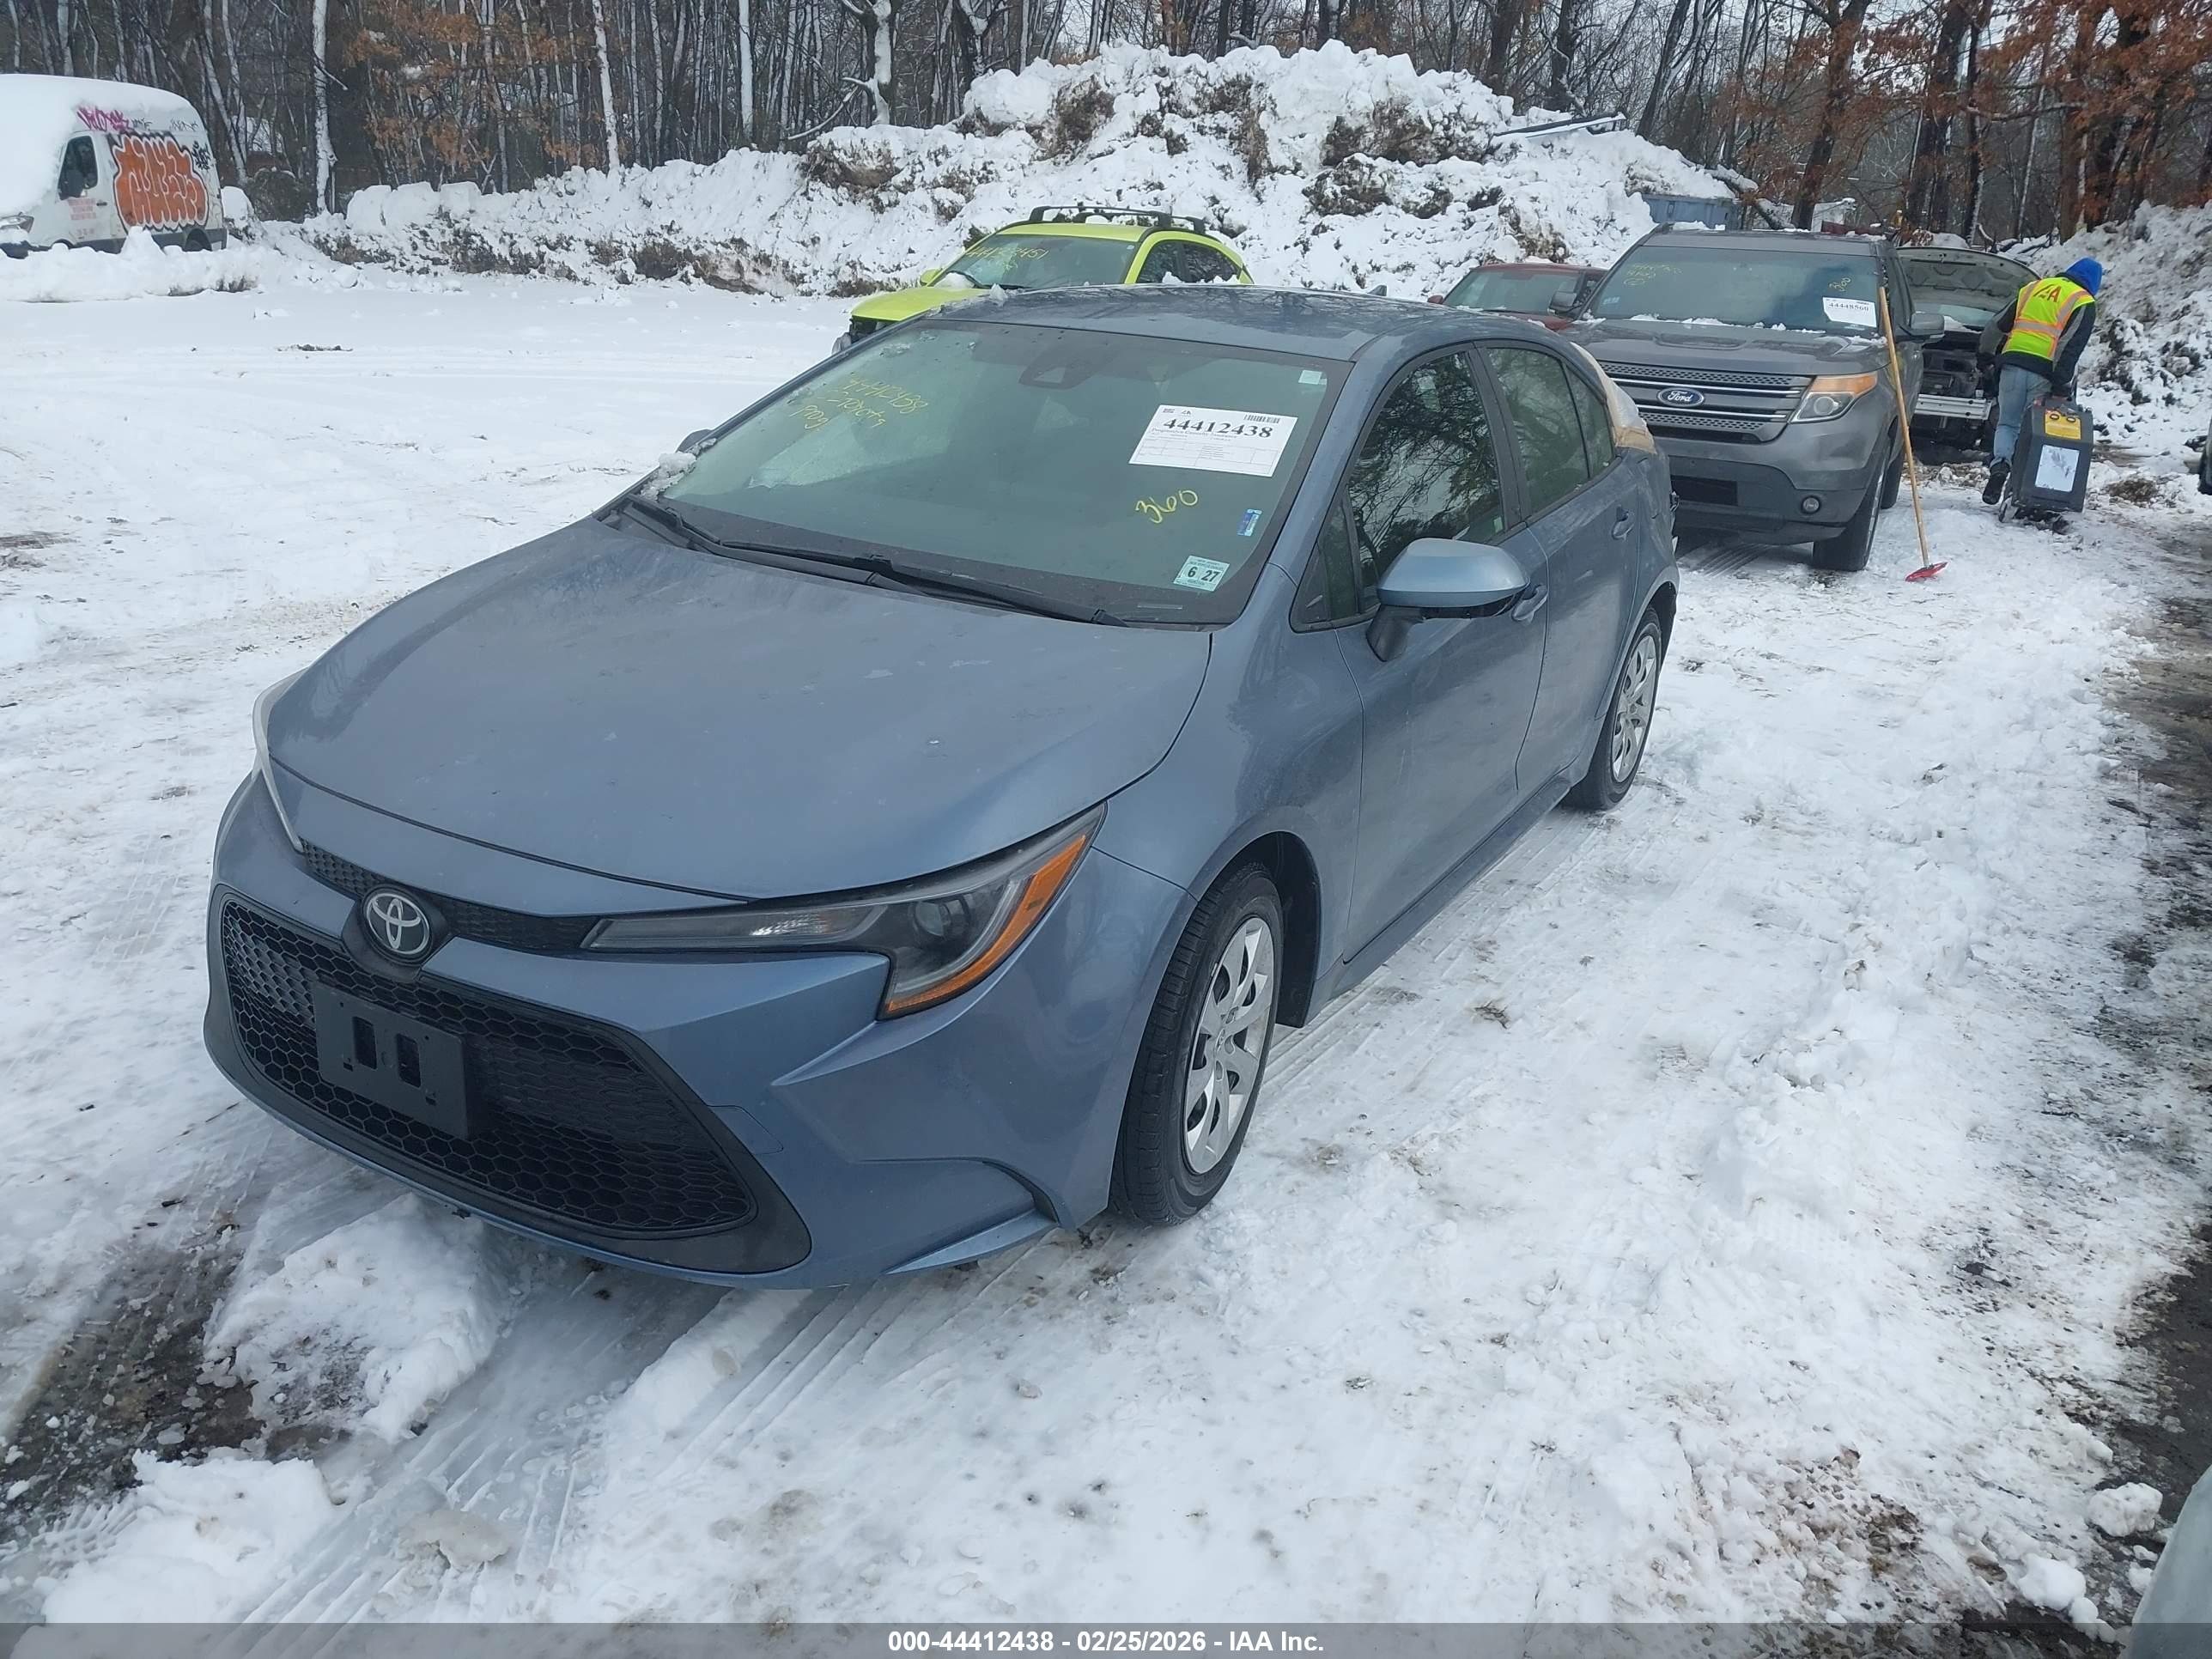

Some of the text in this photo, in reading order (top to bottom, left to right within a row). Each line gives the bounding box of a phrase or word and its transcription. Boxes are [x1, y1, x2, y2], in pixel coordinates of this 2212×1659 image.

[1668, 391, 1693, 402] Ford
[1164, 418, 1273, 438] 44412438
[1135, 489, 1199, 524] 360
[1188, 566, 1198, 578] 6
[1201, 569, 1221, 582] 27
